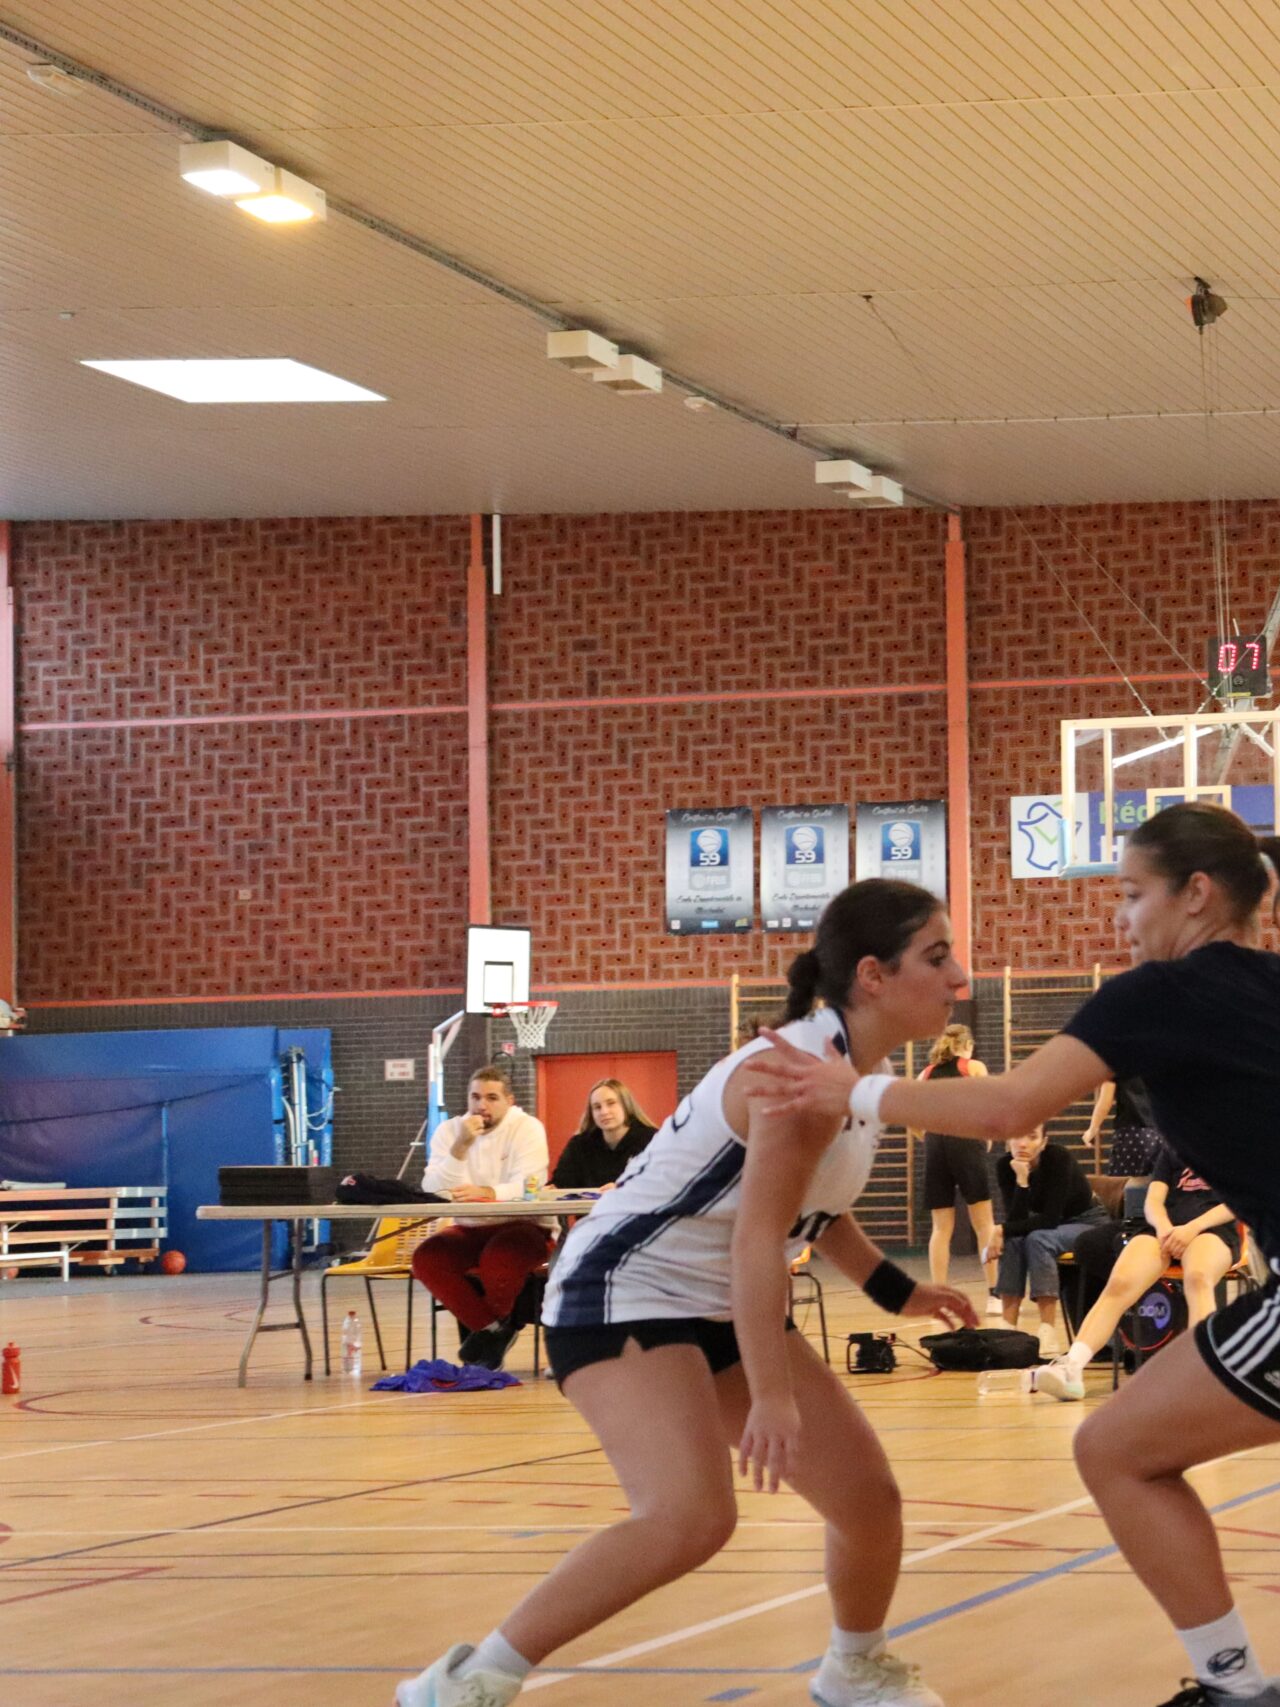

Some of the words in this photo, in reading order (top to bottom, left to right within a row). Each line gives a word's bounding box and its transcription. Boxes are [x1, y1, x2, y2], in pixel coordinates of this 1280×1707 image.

[1218, 643, 1260, 672] 07
[699, 852, 721, 866] 59
[794, 850, 816, 864] 59
[891, 846, 912, 860] 59
